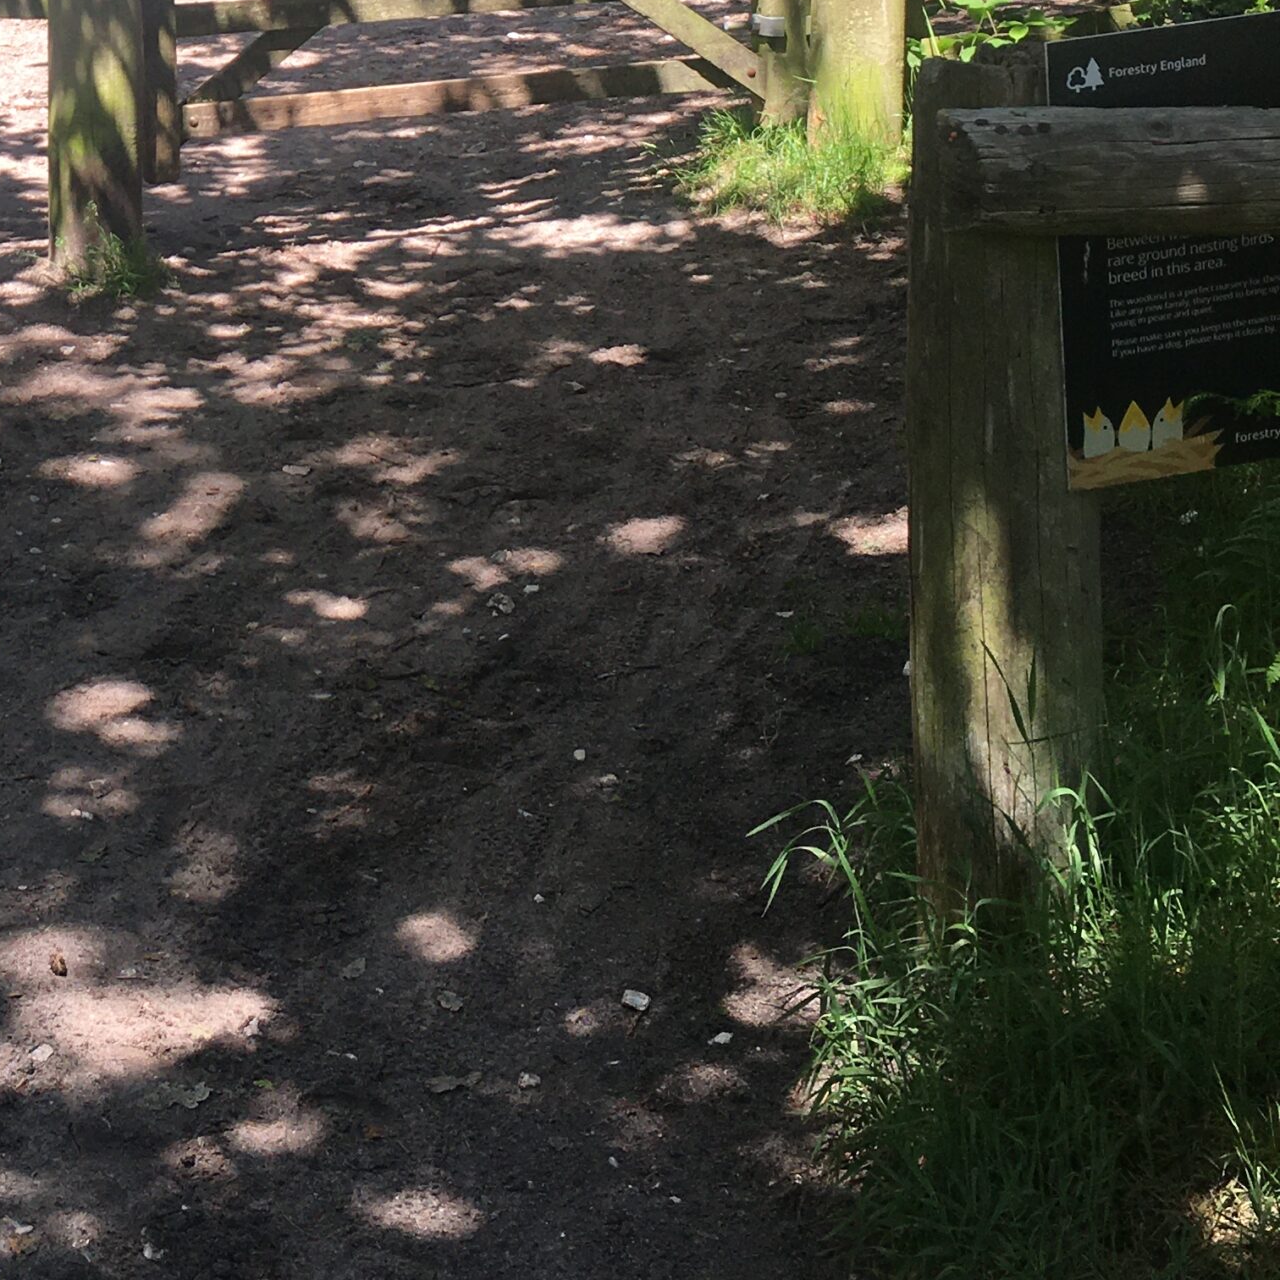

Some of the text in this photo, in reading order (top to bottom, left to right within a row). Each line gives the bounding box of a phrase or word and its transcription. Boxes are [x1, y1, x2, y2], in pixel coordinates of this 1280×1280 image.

[1109, 54, 1207, 78] Forestry England
[1108, 233, 1274, 267] rare ground nesting birds
[1108, 258, 1227, 285] breed in this area.
[1110, 299, 1125, 308] The
[1263, 274, 1280, 284] thes
[1145, 304, 1162, 312] new
[1270, 314, 1280, 322] tra
[1235, 428, 1280, 444] forestry
